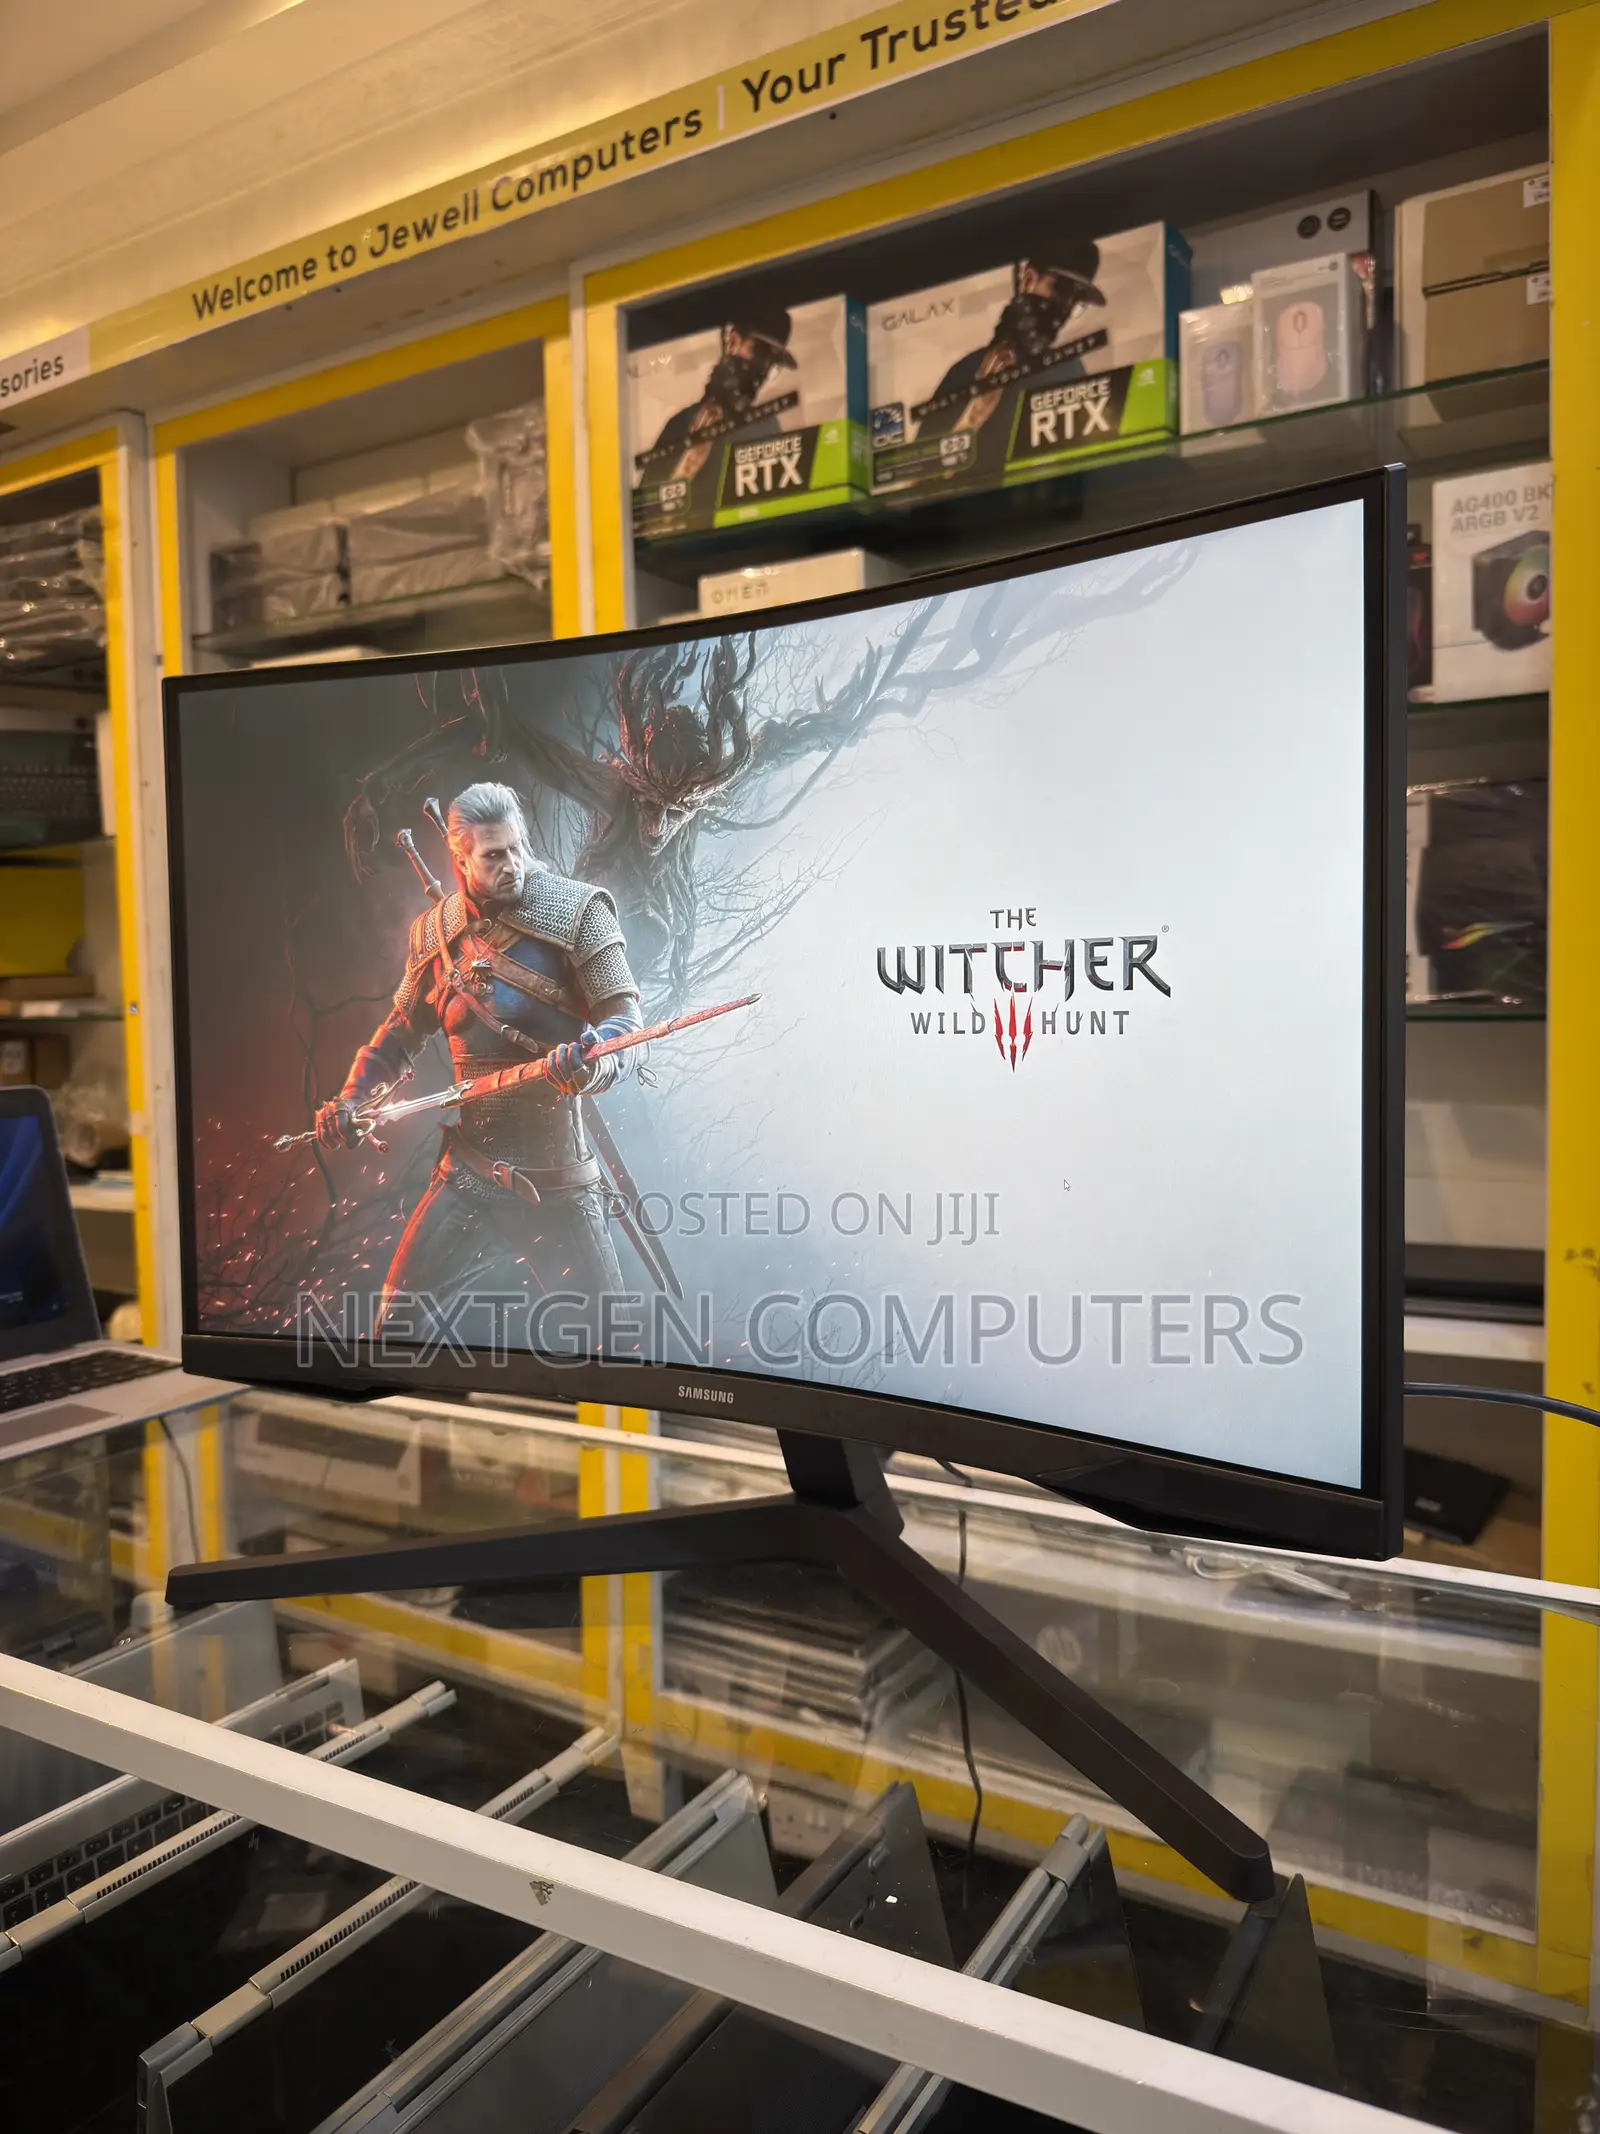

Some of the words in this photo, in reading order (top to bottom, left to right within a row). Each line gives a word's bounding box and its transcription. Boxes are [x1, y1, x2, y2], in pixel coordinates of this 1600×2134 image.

[191, 256, 318, 321] Welcome
[326, 244, 358, 273] to
[369, 187, 480, 258] Jewell
[491, 108, 703, 213] Computers
[741, 53, 846, 113] Your
[881, 298, 956, 331] GALAX
[0, 355, 64, 398] sories
[1030, 376, 1112, 412] GEFORCE
[1030, 395, 1111, 448] RTX
[734, 435, 802, 464] GEFORCE
[734, 454, 804, 498] RTX
[1451, 489, 1518, 516] AG400
[1451, 510, 1507, 532] ARGB
[1512, 504, 1540, 523] V2
[989, 907, 1037, 931] THE
[876, 934, 1172, 1002] WITCHER
[910, 1007, 986, 1036] WILD
[1041, 1007, 1130, 1036] HUNT
[678, 1385, 735, 1404] SAMSUNG
